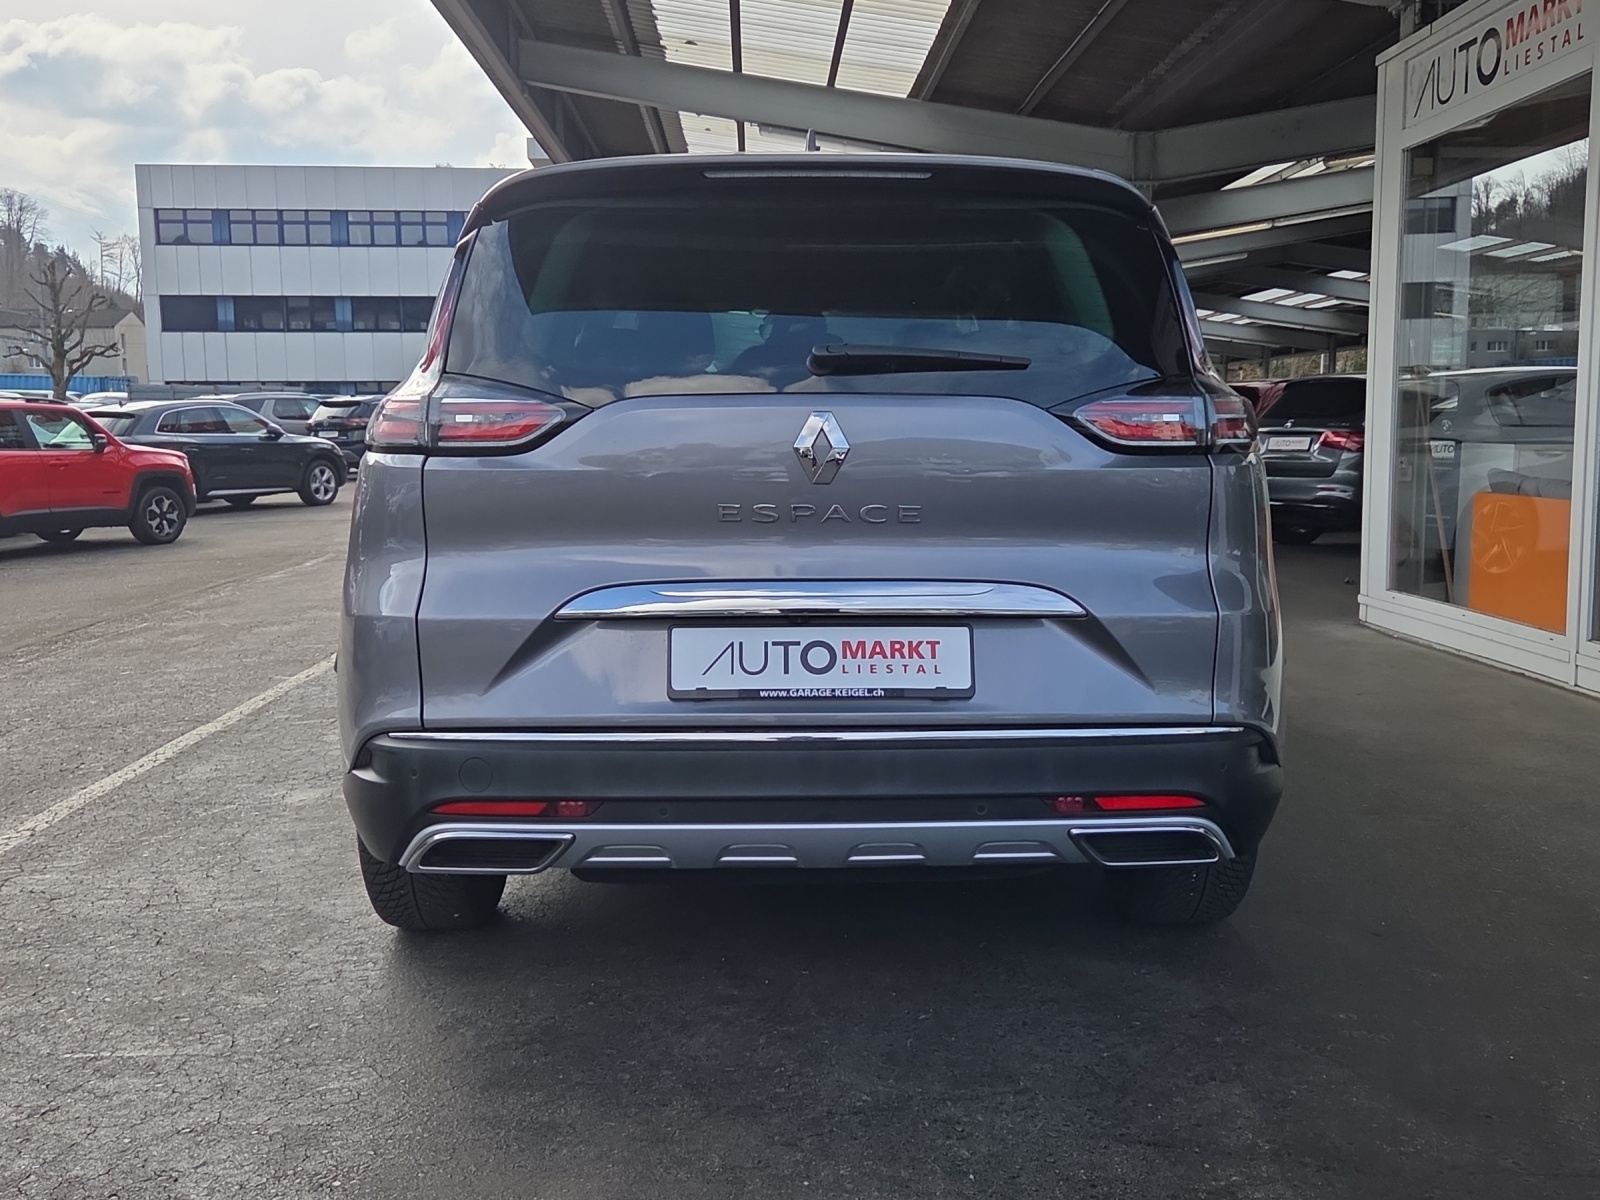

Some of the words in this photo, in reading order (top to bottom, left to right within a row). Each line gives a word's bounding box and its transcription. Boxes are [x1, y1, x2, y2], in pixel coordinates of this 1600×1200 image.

[1503, 22, 1584, 76] LIESTAL
[1413, 27, 1502, 119] AUTO
[717, 503, 923, 524] ESPACE
[701, 639, 838, 676] AUTO
[841, 640, 941, 660] MARKT
[841, 663, 942, 675] LIESTAL
[759, 688, 885, 698] www.GARAGE-KEIGEL.ch
